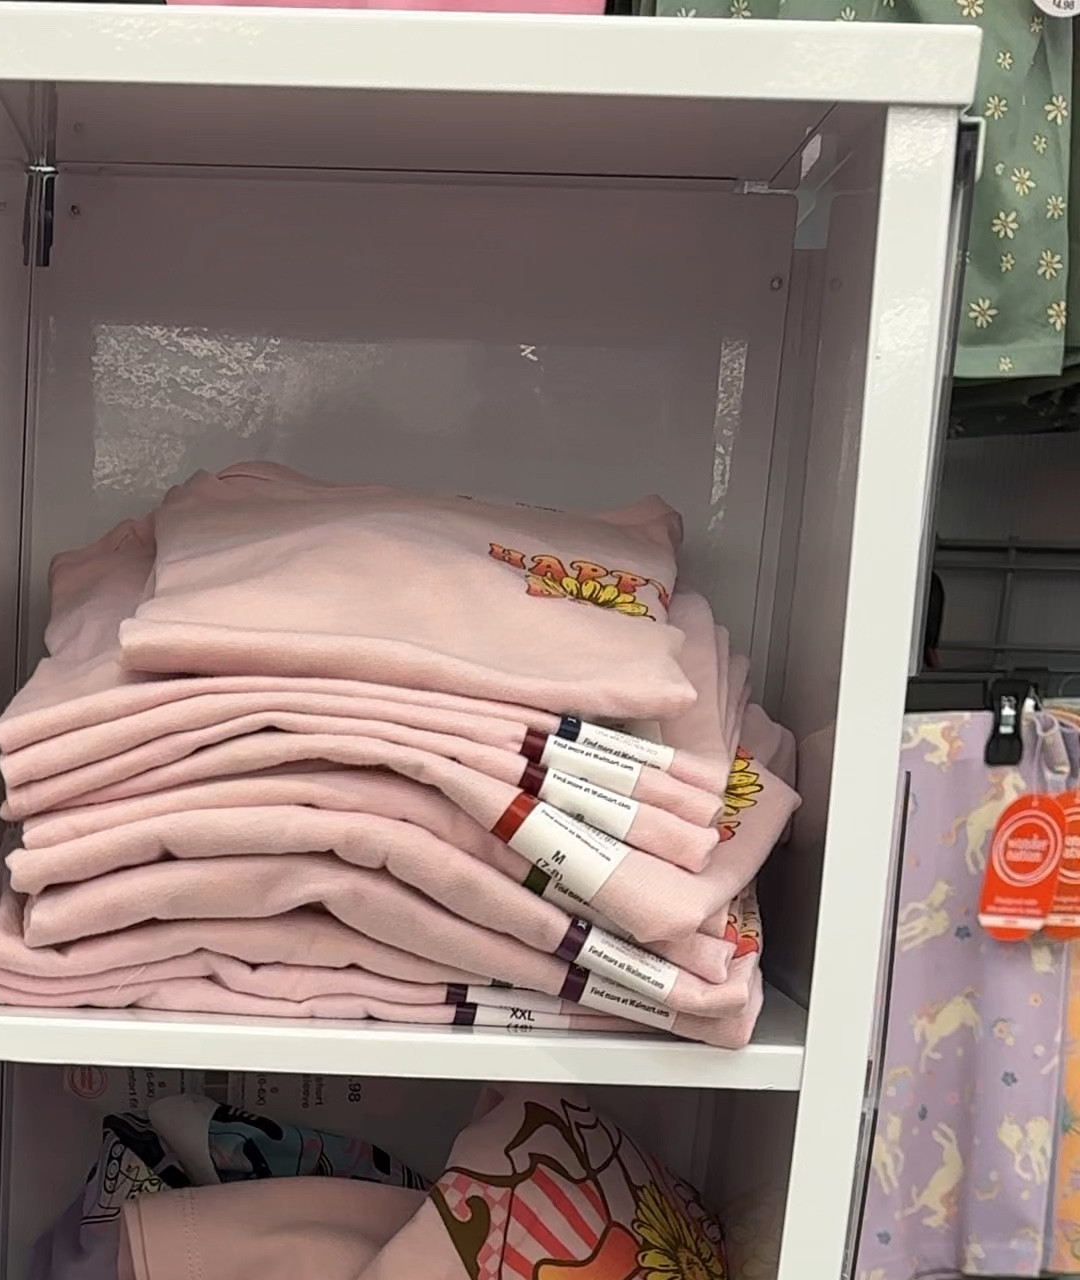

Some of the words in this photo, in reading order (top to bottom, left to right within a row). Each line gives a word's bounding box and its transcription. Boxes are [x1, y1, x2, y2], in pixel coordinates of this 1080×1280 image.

[554, 739, 567, 750] Find
[568, 745, 584, 755] more
[593, 752, 634, 771] Walmart.com
[552, 773, 566, 784] Find
[567, 779, 583, 790] more
[591, 788, 631, 810] Walmart.com
[551, 849, 567, 865] M
[588, 945, 602, 957] Find
[602, 955, 618, 966] more
[625, 964, 665, 989] Walmart.com
[510, 1007, 535, 1022] XXL
[590, 986, 605, 998] Find
[605, 992, 621, 1002] more
[629, 998, 670, 1018] Walmart.com
